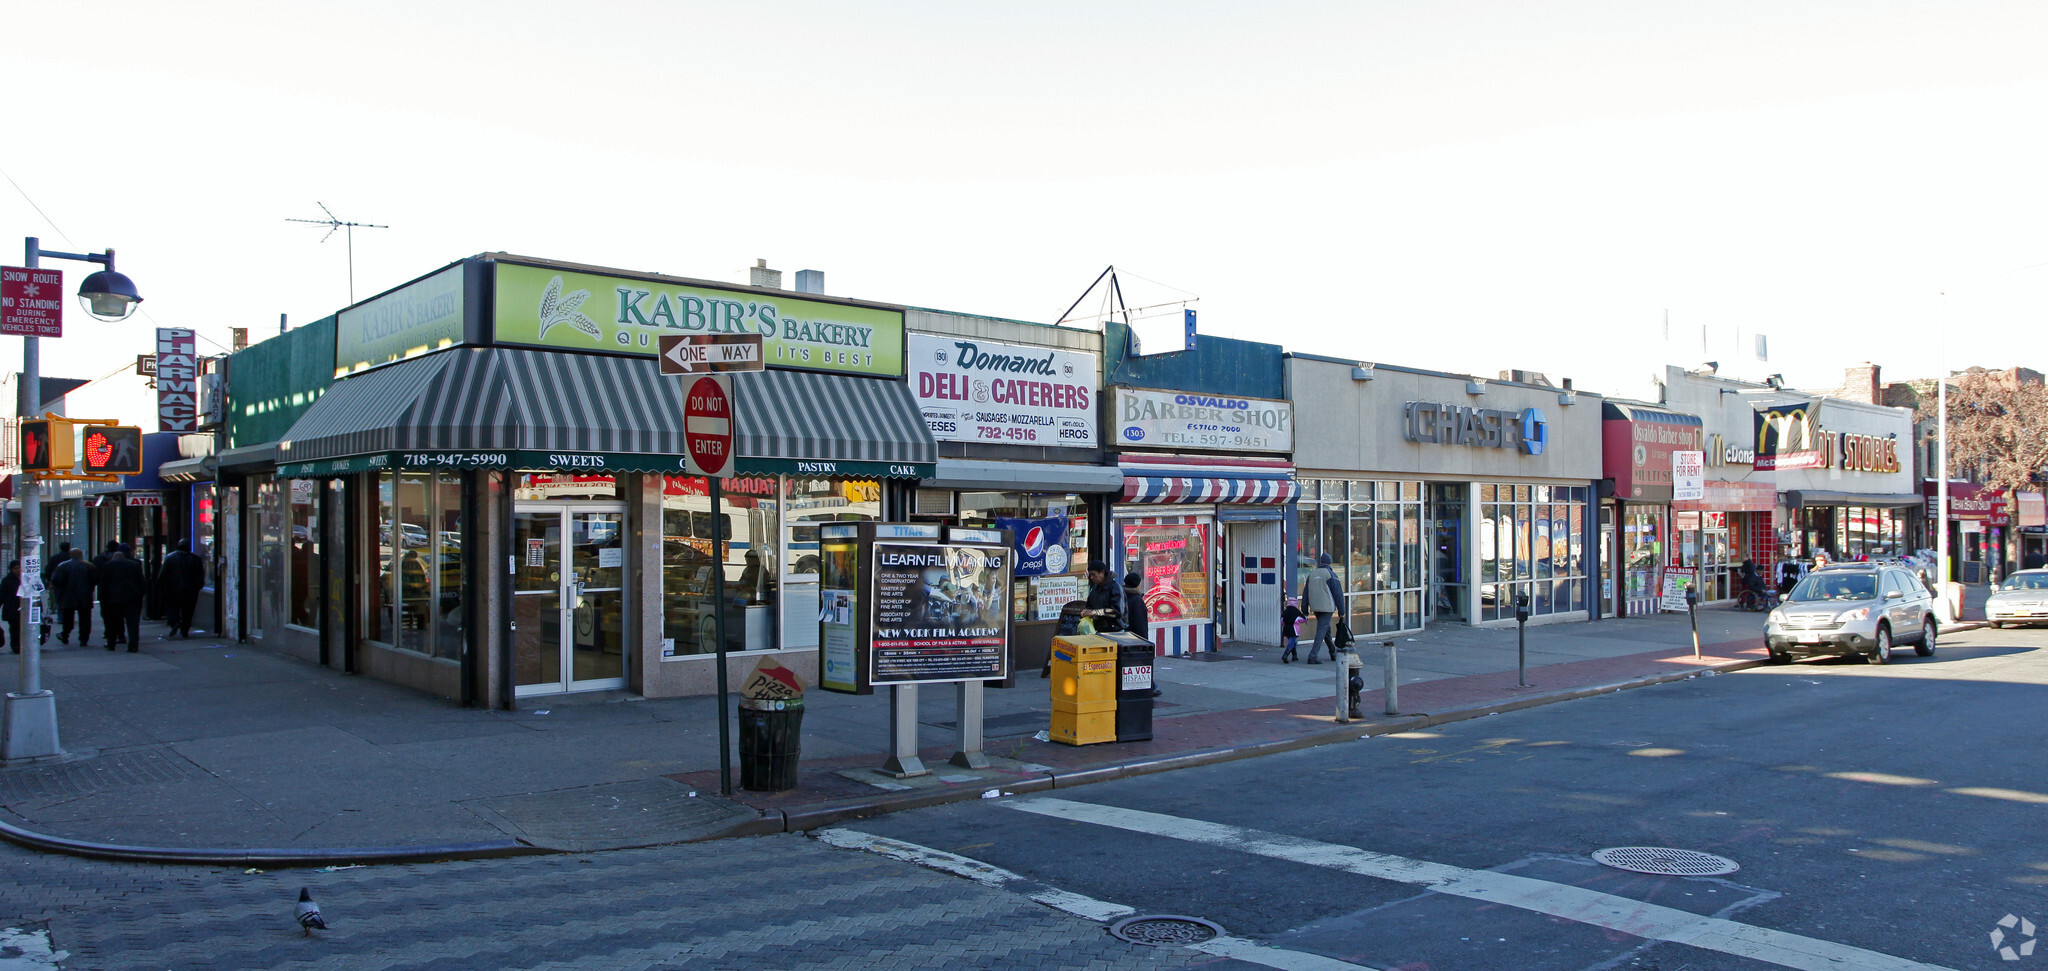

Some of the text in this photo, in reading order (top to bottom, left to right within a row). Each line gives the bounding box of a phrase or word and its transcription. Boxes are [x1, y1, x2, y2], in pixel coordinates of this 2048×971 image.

[4, 271, 59, 284] SNOW ROUTE
[2, 297, 60, 310] NO STANDING
[17, 309, 46, 317] DURING
[361, 290, 457, 344] KABIR'S BAKERY
[617, 288, 872, 348] KABIR'S BAKERY
[7, 316, 55, 325] EMERGENCY
[2, 324, 60, 334] VEHICLES TOWED
[679, 346, 752, 362] ONE WAY
[778, 346, 873, 366] IT'S BEST
[955, 342, 1057, 376] Domand
[159, 329, 195, 430] PHARMACY
[919, 371, 1089, 410] DELI & CATERERS
[692, 396, 723, 412] DO NOT
[1174, 395, 1249, 410] OSVALDO
[976, 412, 1007, 424] SAUSAGES
[1012, 414, 1055, 426] MOZZARELLA
[1123, 394, 1290, 432] BARBER SHOP
[927, 421, 956, 432] EESES
[1187, 423, 1241, 433] ESTILO 2000
[1408, 402, 1518, 448] CHASE
[1060, 429, 1088, 439] HEROS
[1125, 429, 1144, 437] 1303
[1634, 423, 1692, 450] Osvaldo Barber shop
[1162, 432, 1269, 448] TEL: 597-9451
[695, 439, 723, 456] ENTER
[1710, 434, 1754, 466] McDona
[1842, 433, 1898, 472] STORES
[404, 453, 506, 466] 718-947-5990
[550, 455, 604, 466] SWEETS
[1681, 453, 1696, 464] STORE
[798, 462, 837, 472] PASTRY
[890, 465, 916, 475] CAKE
[1677, 466, 1686, 476] FOR
[1687, 466, 1700, 476] RENT
[1634, 470, 1660, 481] MULTI
[592, 522, 602, 532] A
[831, 526, 849, 537] TITAN
[893, 526, 923, 537] TITAN
[1146, 539, 1187, 551] International
[882, 554, 1001, 567] LEARN FILMMAKING
[1022, 559, 1043, 570] pepsi
[1043, 588, 1072, 596] CHRISTMAS
[1039, 596, 1076, 605] FLEA MARKET
[878, 628, 999, 638] NEW YORK FILM ACADEMY
[1122, 667, 1132, 675] LA
[749, 675, 793, 697] Pizza
